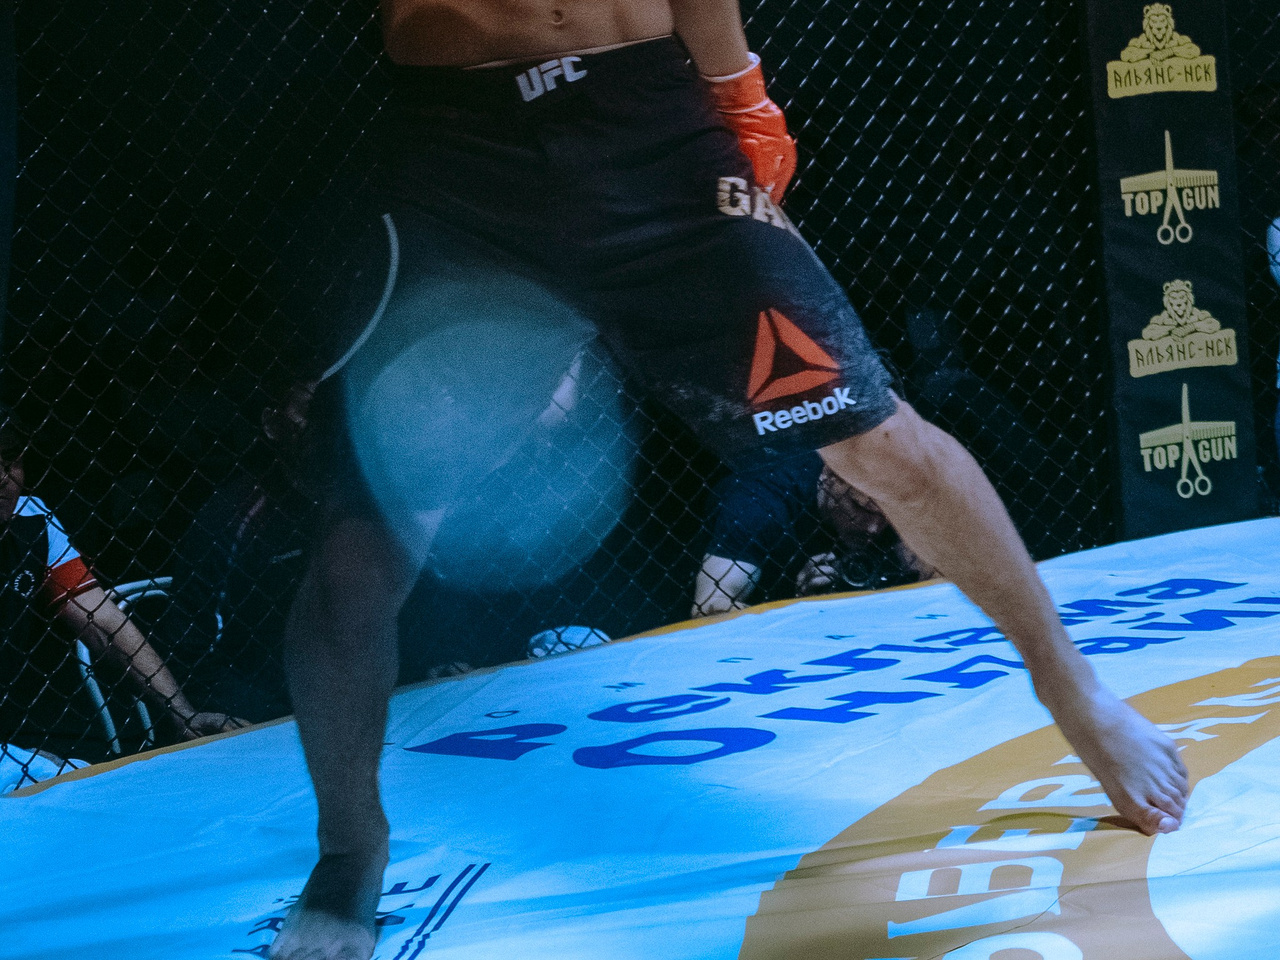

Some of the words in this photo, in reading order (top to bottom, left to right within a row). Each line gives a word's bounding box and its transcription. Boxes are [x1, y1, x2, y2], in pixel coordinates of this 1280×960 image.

[516, 55, 588, 103] UFC
[1113, 62, 1213, 88] АЛЬЯНС-НСК
[1121, 192, 1163, 217] TOP
[1182, 184, 1220, 211] GUN
[1135, 343, 1234, 368] АЛЬЯНС-НСК
[753, 386, 857, 436] Reebok
[1141, 447, 1181, 472] TOP
[1199, 435, 1237, 464] GUN
